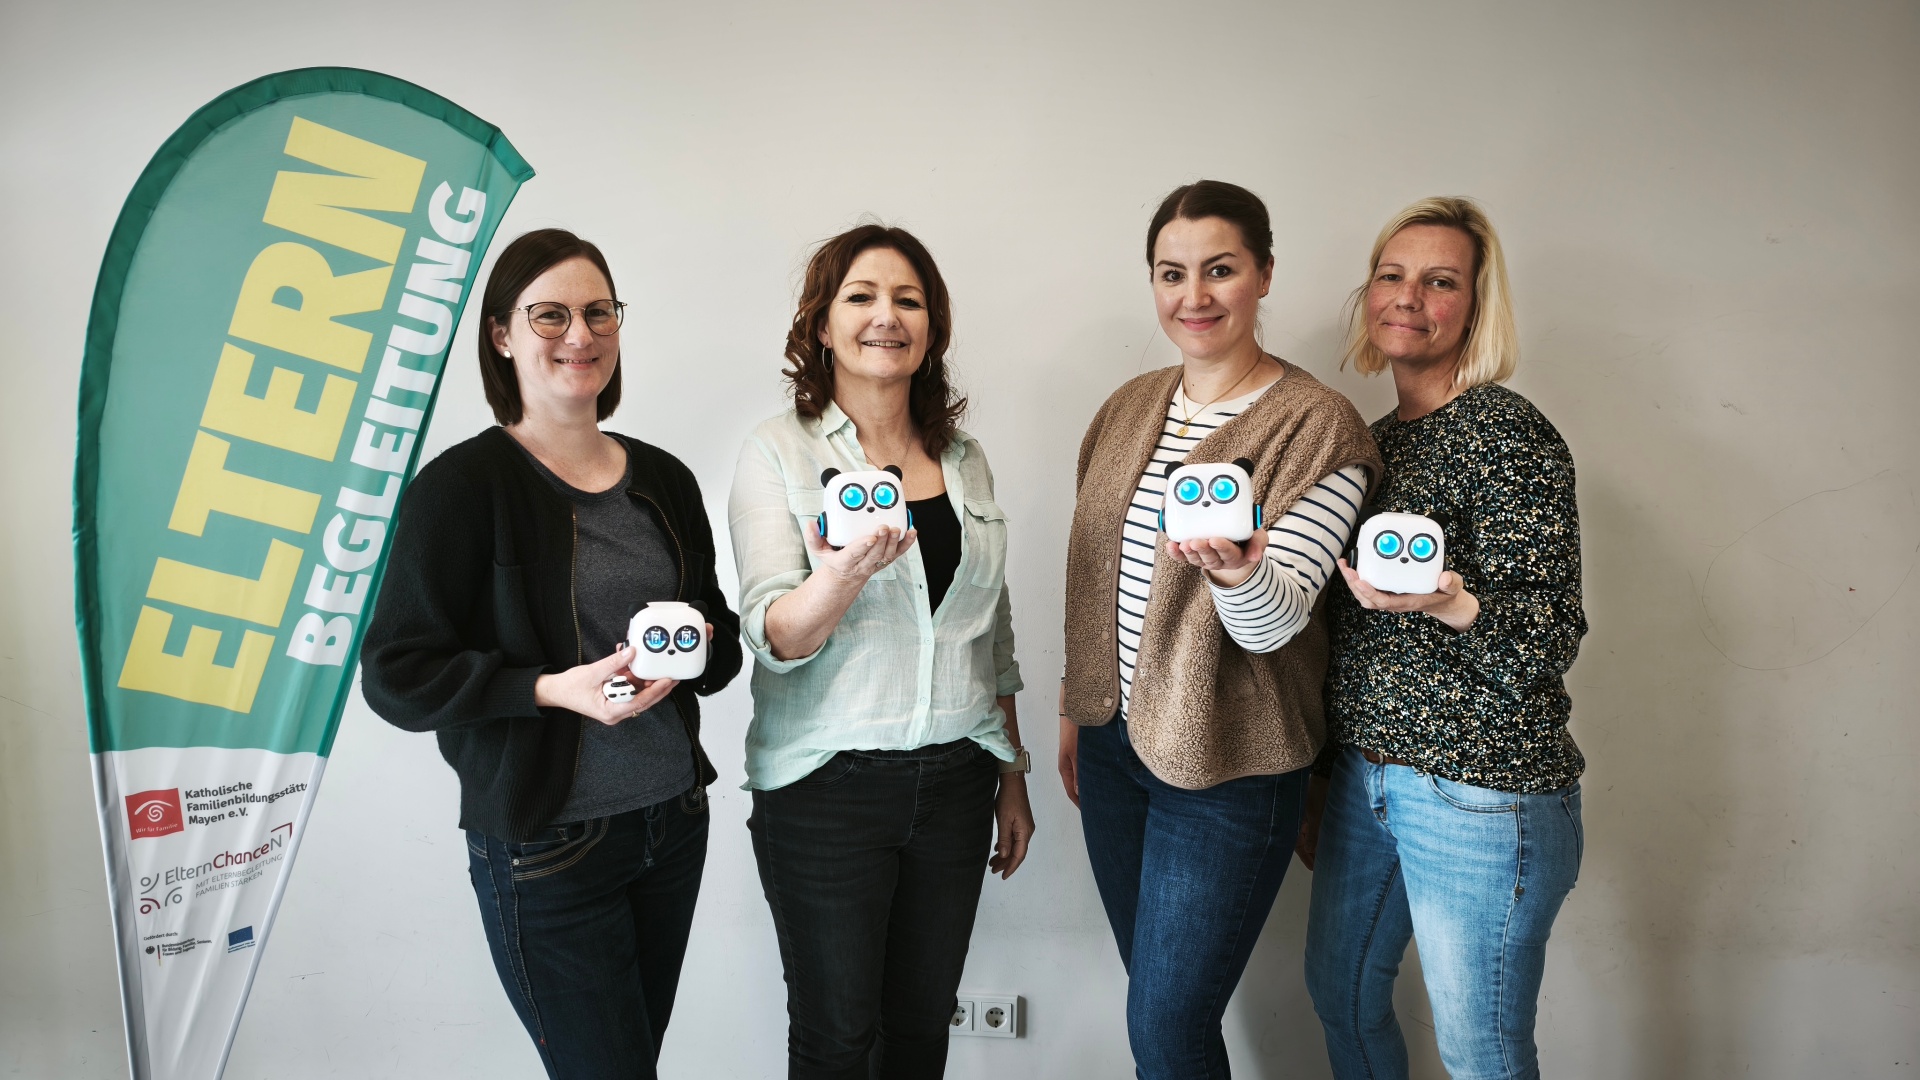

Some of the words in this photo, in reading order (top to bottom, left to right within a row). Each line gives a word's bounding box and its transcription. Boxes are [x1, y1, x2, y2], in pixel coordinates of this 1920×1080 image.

[118, 116, 427, 714] ELTERN
[286, 180, 486, 667] BEGLEITUNG
[185, 782, 253, 799] Katholische
[187, 782, 308, 812] Familienbildungsstätt
[156, 822, 178, 831] Familie
[188, 813, 225, 826] Mayen
[165, 834, 282, 886] ElternChanceN
[195, 877, 209, 890] MIT
[212, 853, 283, 883] ELTERNBEGLEITUNG
[195, 881, 230, 899] FAMILIEN
[231, 869, 263, 888] STÄRKEN
